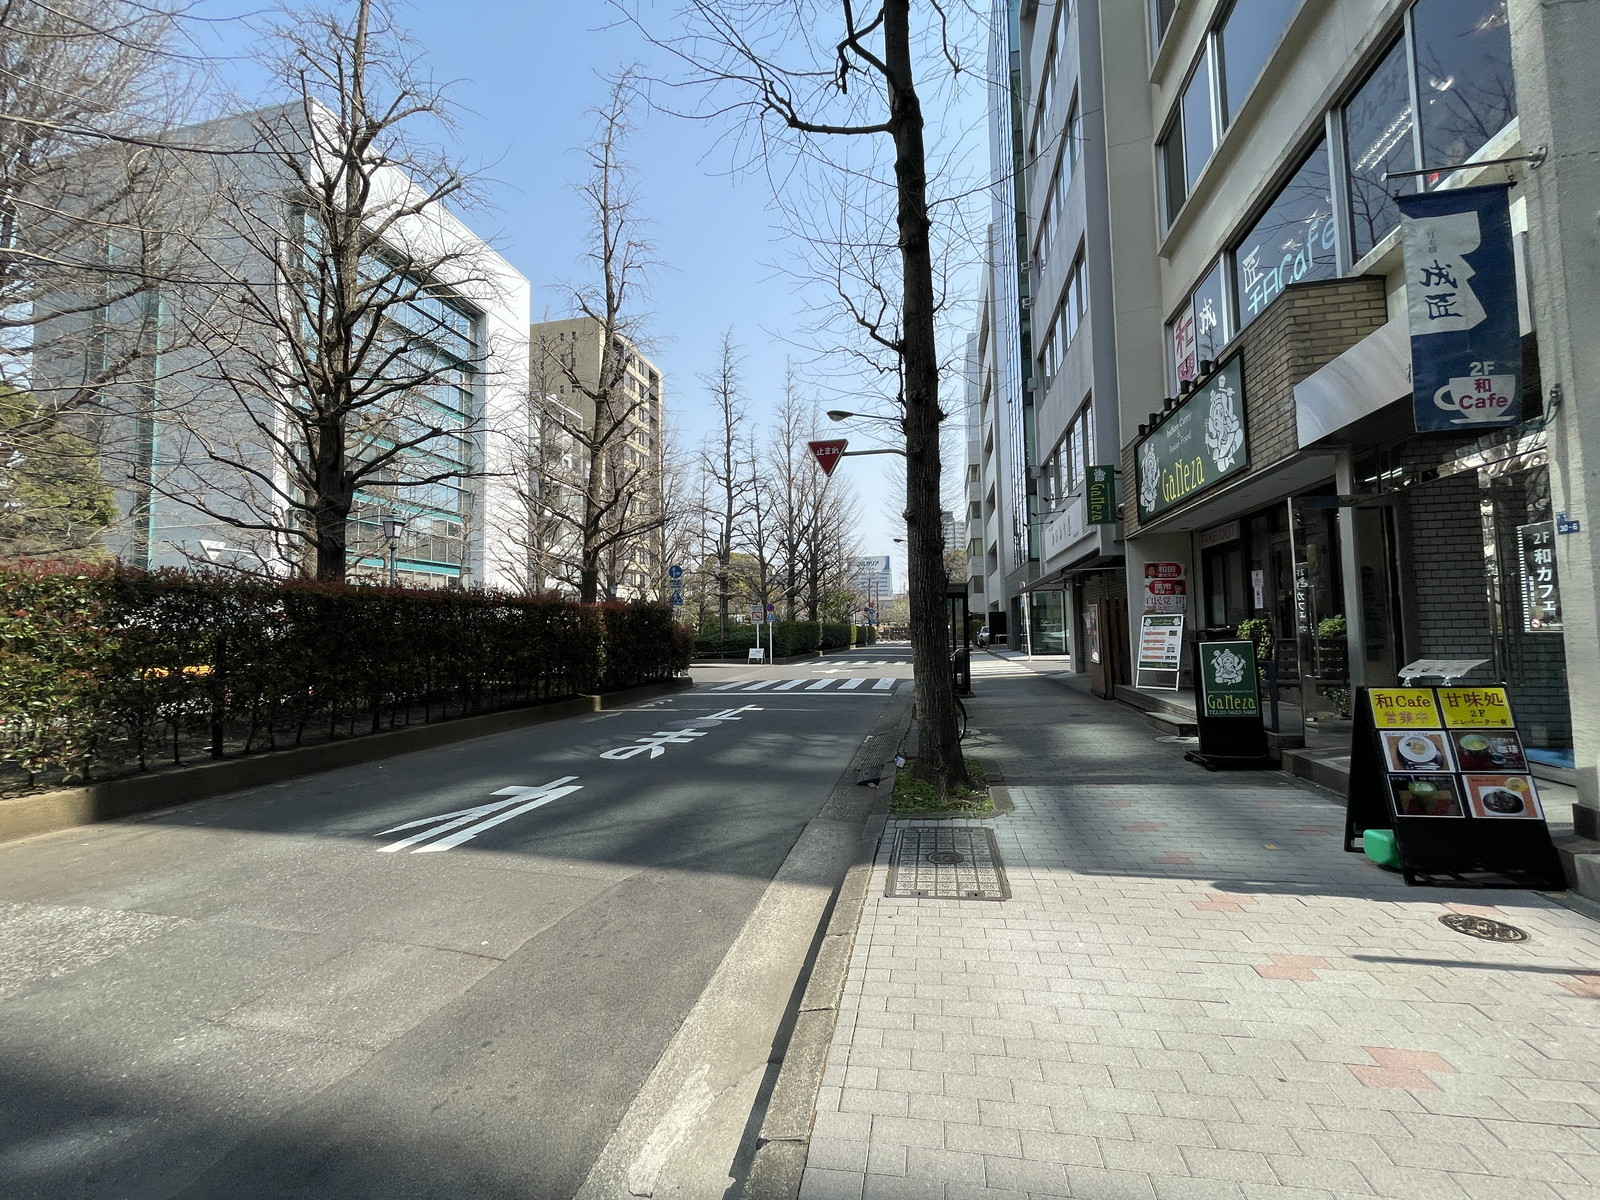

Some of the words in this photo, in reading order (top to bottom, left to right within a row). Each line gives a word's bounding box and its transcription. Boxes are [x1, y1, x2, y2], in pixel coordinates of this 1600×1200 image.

[1419, 259, 1463, 320] 成匠
[1469, 361, 1495, 377] 2F
[1474, 378, 1492, 394] 和
[1458, 393, 1508, 410] Cafe
[816, 447, 839, 456] 止まれ
[1219, 524, 1236, 540] OUT
[1559, 523, 1578, 532] 30-6
[1533, 532, 1550, 545] 2F
[1533, 548, 1557, 612] 和カフェ
[1207, 694, 1256, 710] GaNeza
[1375, 694, 1431, 709] 和Cafe
[1443, 692, 1505, 708] 甘味処
[1383, 711, 1429, 724] 営業中
[1470, 709, 1486, 718] 2F
